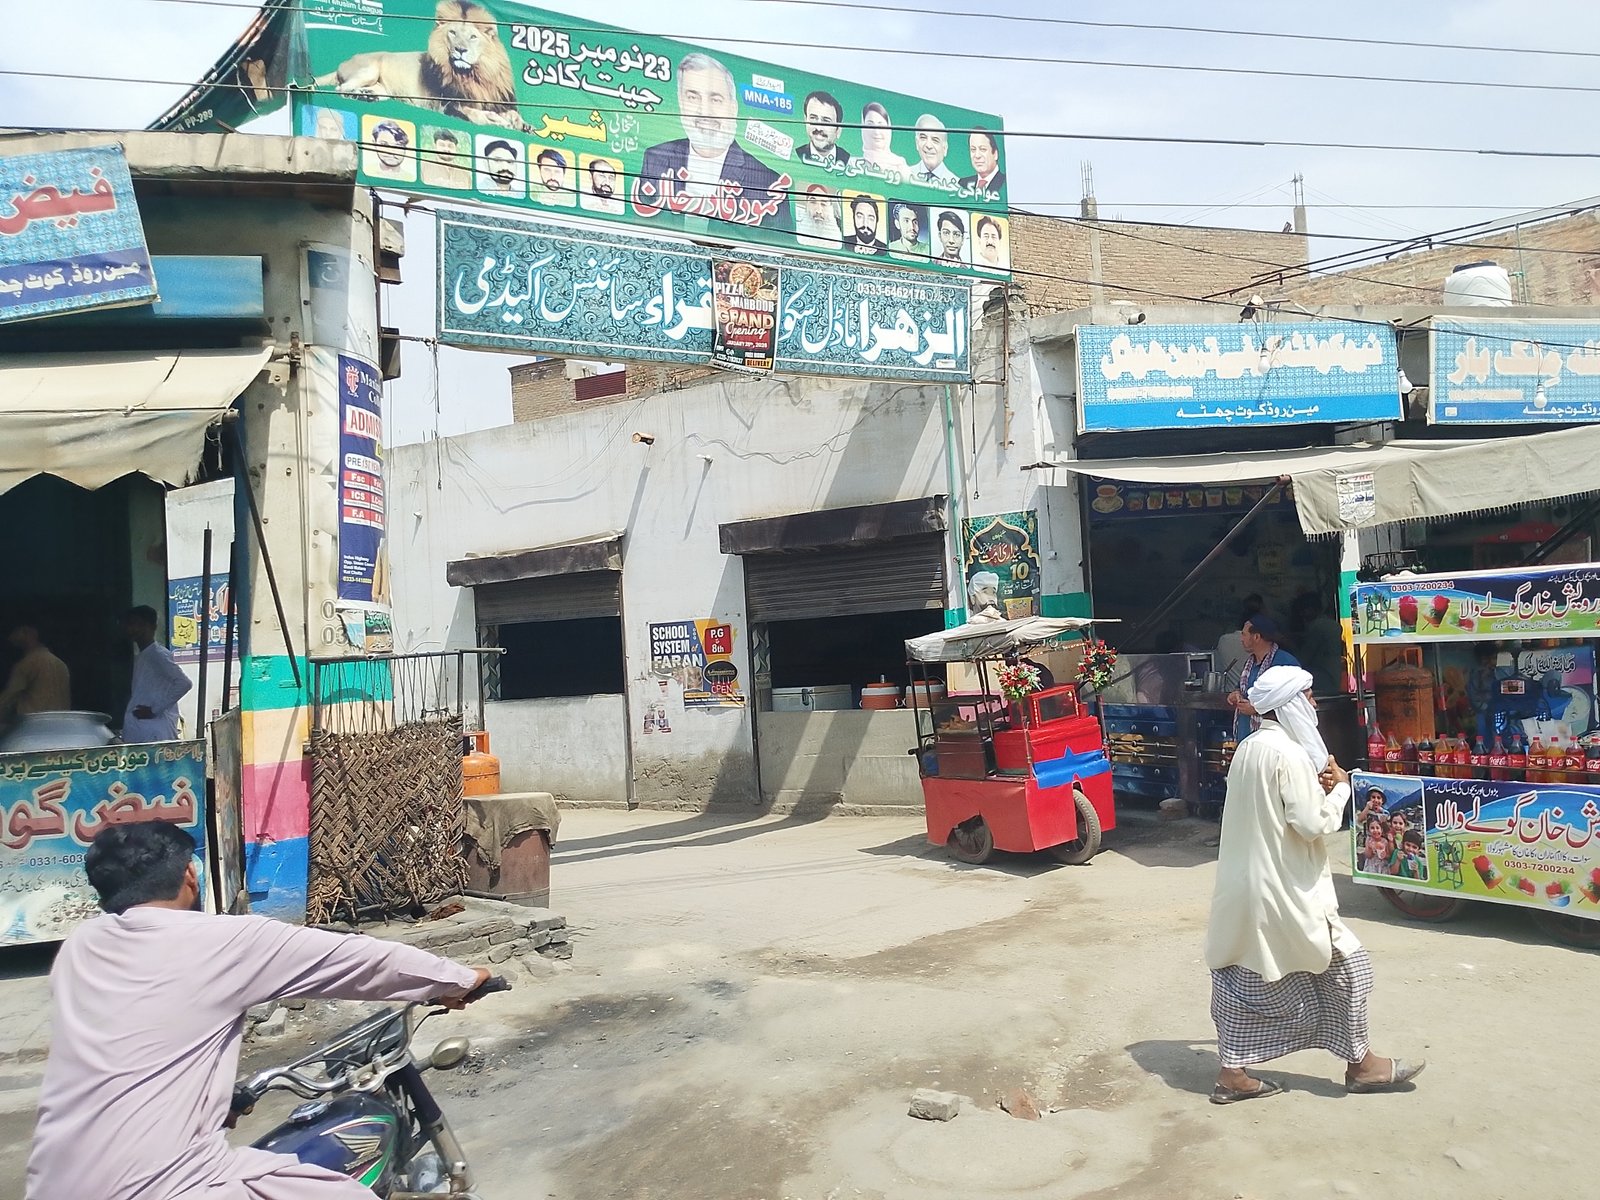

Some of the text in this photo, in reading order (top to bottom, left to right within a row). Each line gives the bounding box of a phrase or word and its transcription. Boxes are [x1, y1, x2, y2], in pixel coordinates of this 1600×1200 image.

[511, 24, 672, 81] 23 نومبر 2025
[522, 58, 664, 112] جیت کا دن
[743, 89, 793, 111] MNA-185
[533, 108, 608, 142] شیر
[610, 135, 639, 154] نشان
[864, 162, 901, 185] ووٹ
[630, 166, 793, 226] محمود قادر خان
[958, 180, 976, 198] کی
[974, 182, 1001, 203] عوام
[0, 166, 117, 236] فیض
[24, 267, 66, 290] کوٹ
[103, 261, 141, 282] مین
[454, 253, 556, 325] اکیڈمی
[540, 255, 645, 323] سائنس
[714, 281, 744, 296] PIZZA
[729, 296, 775, 313] MAHBOOB
[801, 277, 858, 354] ماڈل
[719, 308, 775, 330] GRAND
[725, 321, 767, 340] Opening
[1176, 401, 1320, 422] مین روڈ کوٹ چھٹہ
[1564, 402, 1588, 417] کوٹ
[351, 490, 366, 501] ICS
[1010, 562, 1029, 581] 10
[1459, 596, 1481, 619] والا
[1477, 581, 1532, 618] گولے
[1517, 590, 1552, 620] خان
[652, 625, 690, 640] SCHOOL
[710, 628, 724, 639] P.G
[653, 639, 691, 655] SYSTEM
[711, 644, 725, 653] 8th
[653, 653, 703, 669] FARAN
[86, 750, 150, 774] عورتوں
[0, 777, 72, 851] گو
[1434, 799, 1466, 831] والا
[1464, 789, 1538, 836] گولے
[1517, 806, 1567, 845] خان
[1504, 859, 1576, 875] 0303-7200234
